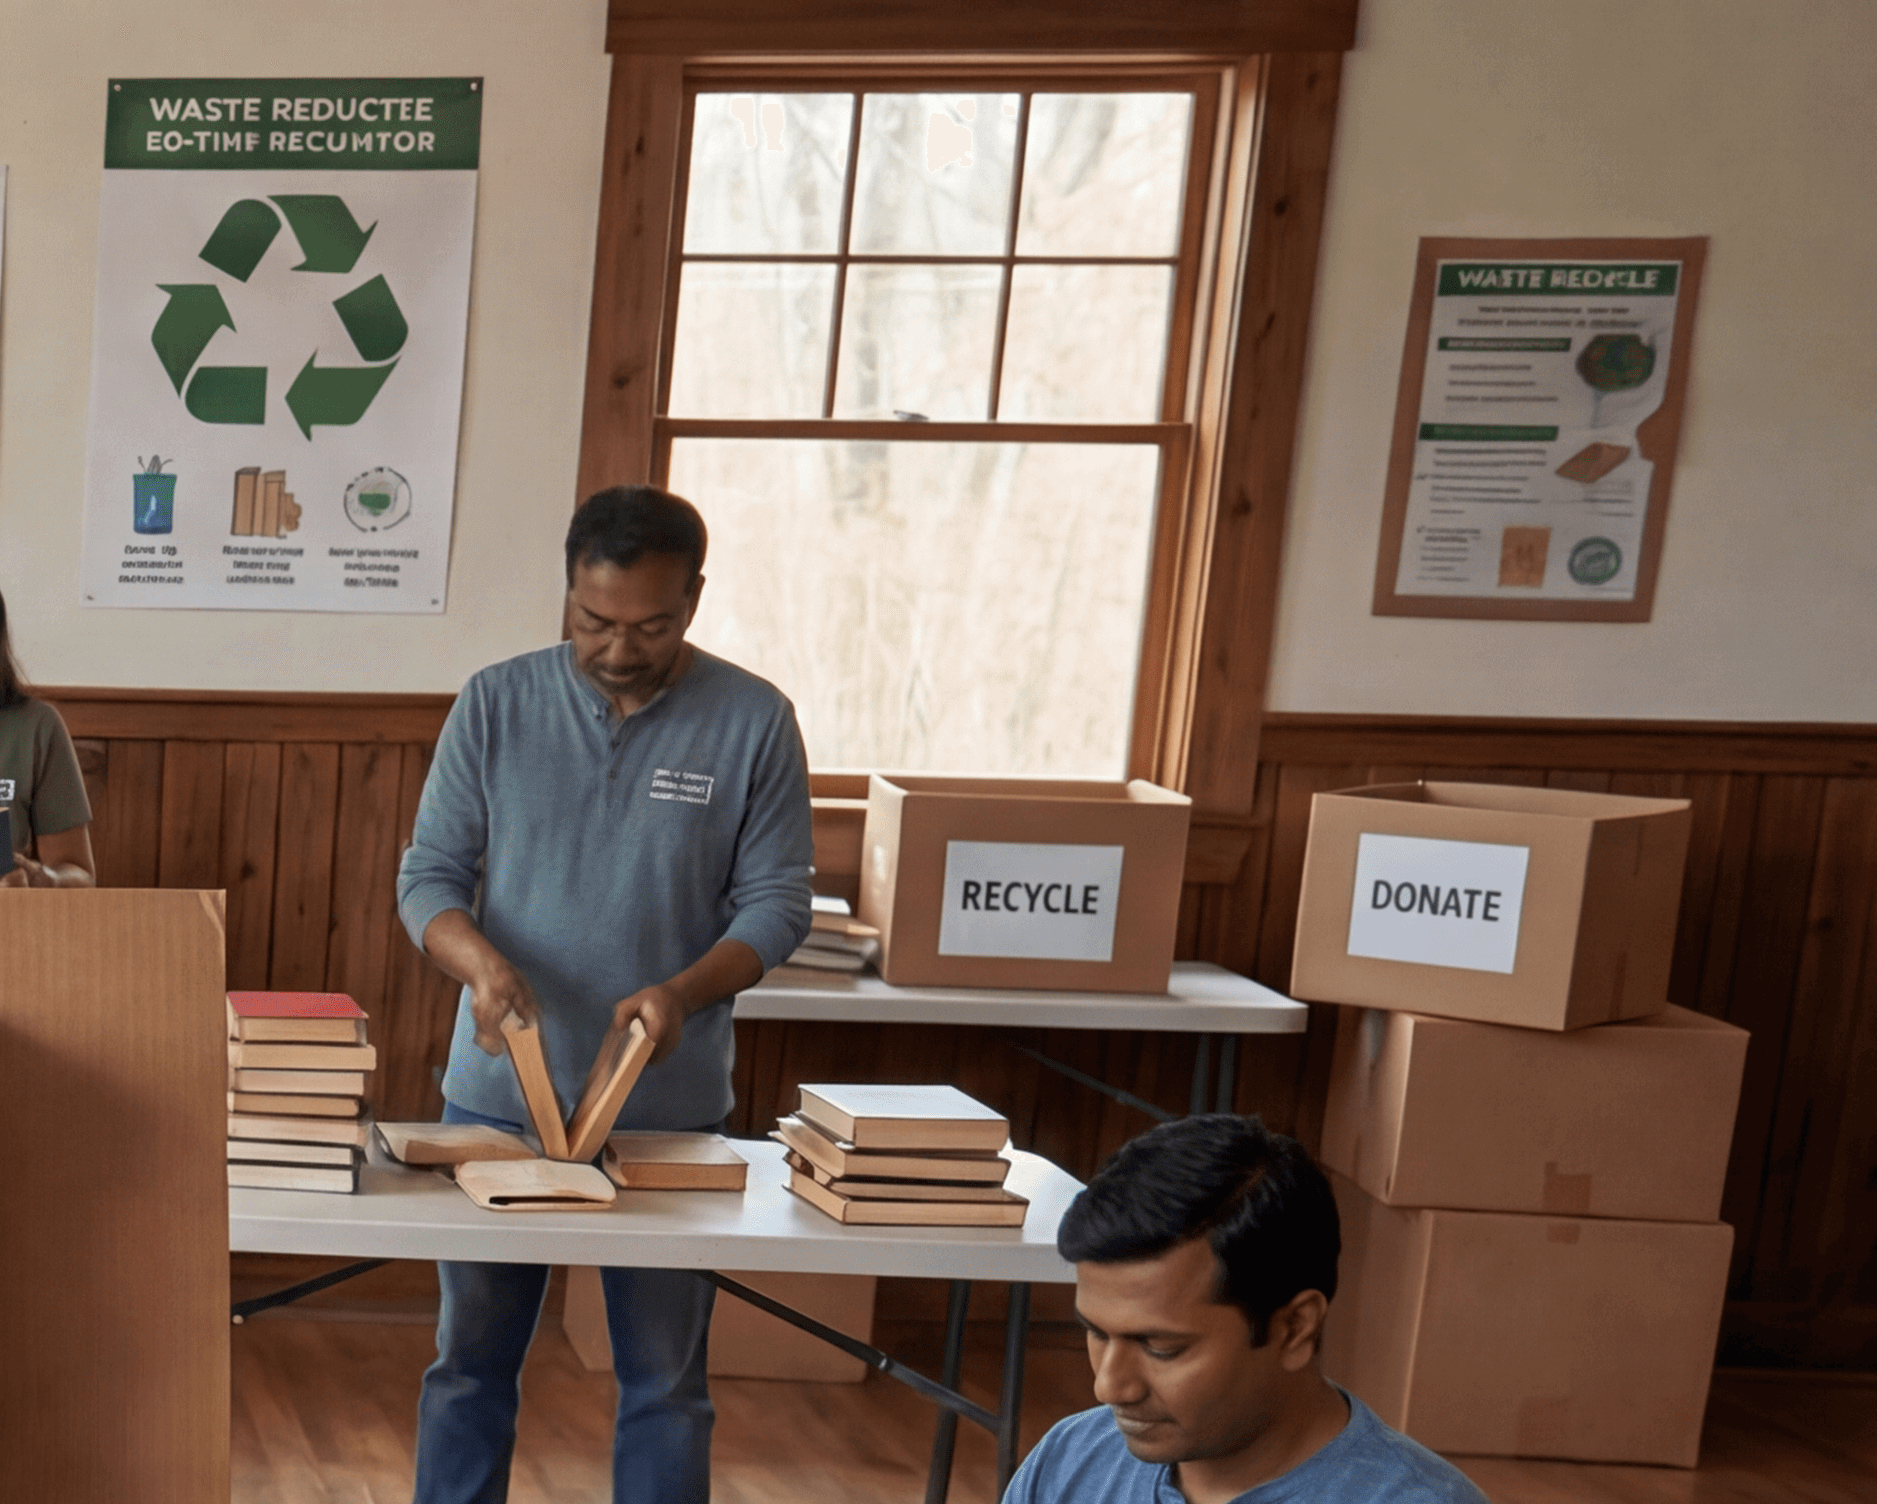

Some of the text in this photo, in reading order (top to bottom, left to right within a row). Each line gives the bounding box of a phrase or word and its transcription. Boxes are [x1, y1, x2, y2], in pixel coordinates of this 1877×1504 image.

[149, 97, 262, 122] WASTE
[962, 880, 1100, 915] RECYCLE
[1371, 879, 1502, 922] DONATE
